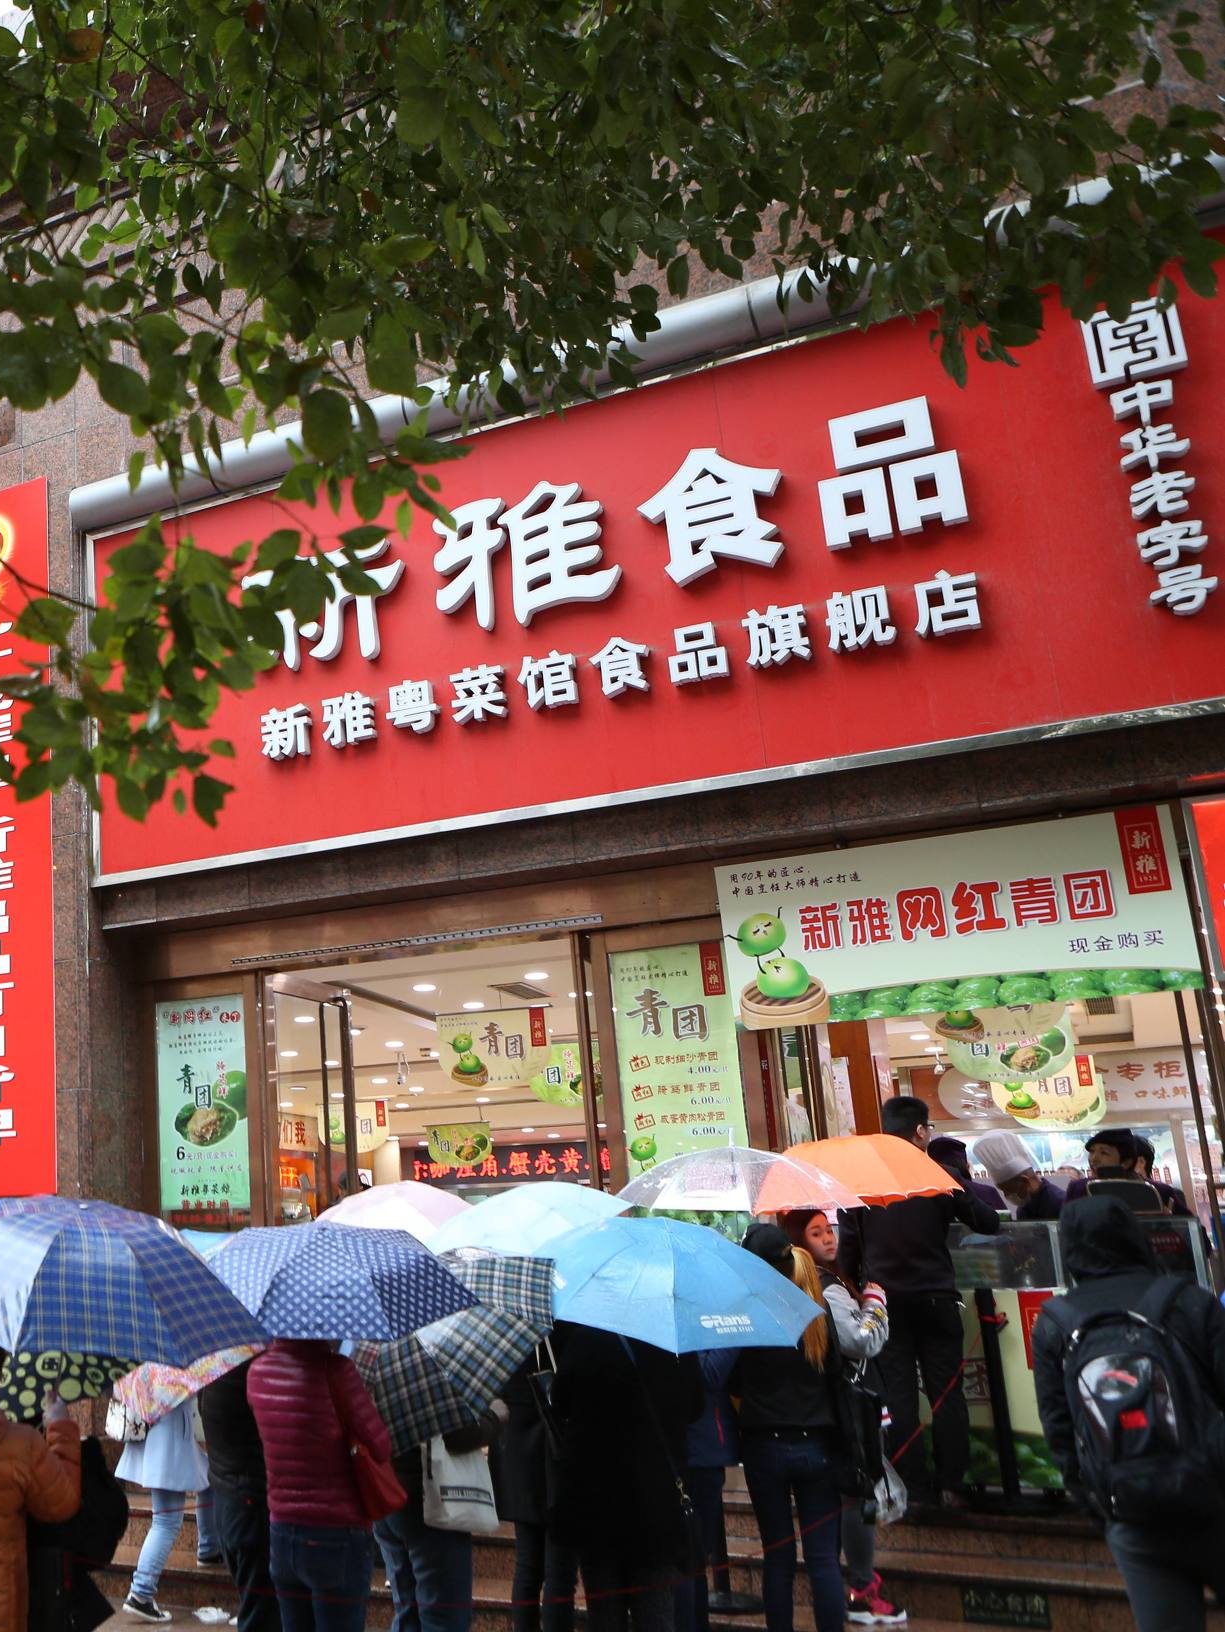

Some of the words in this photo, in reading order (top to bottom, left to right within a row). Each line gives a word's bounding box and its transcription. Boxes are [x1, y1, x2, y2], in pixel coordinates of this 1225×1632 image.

[1108, 378, 1219, 616] 中华老字号
[260, 570, 982, 762] 新雅粤菜馆食品旗舰店
[1131, 830, 1157, 874] 新雅
[732, 872, 862, 899] 中国烹饪大师精心打造
[798, 868, 1117, 952] 新雅网红青团
[1069, 929, 1165, 954] 现金购买
[626, 988, 708, 1040] 青团
[479, 1022, 525, 1059] 青团
[655, 1051, 719, 1065] 现制细沙青团
[177, 1064, 212, 1108] 青团
[546, 1066, 561, 1084] 团
